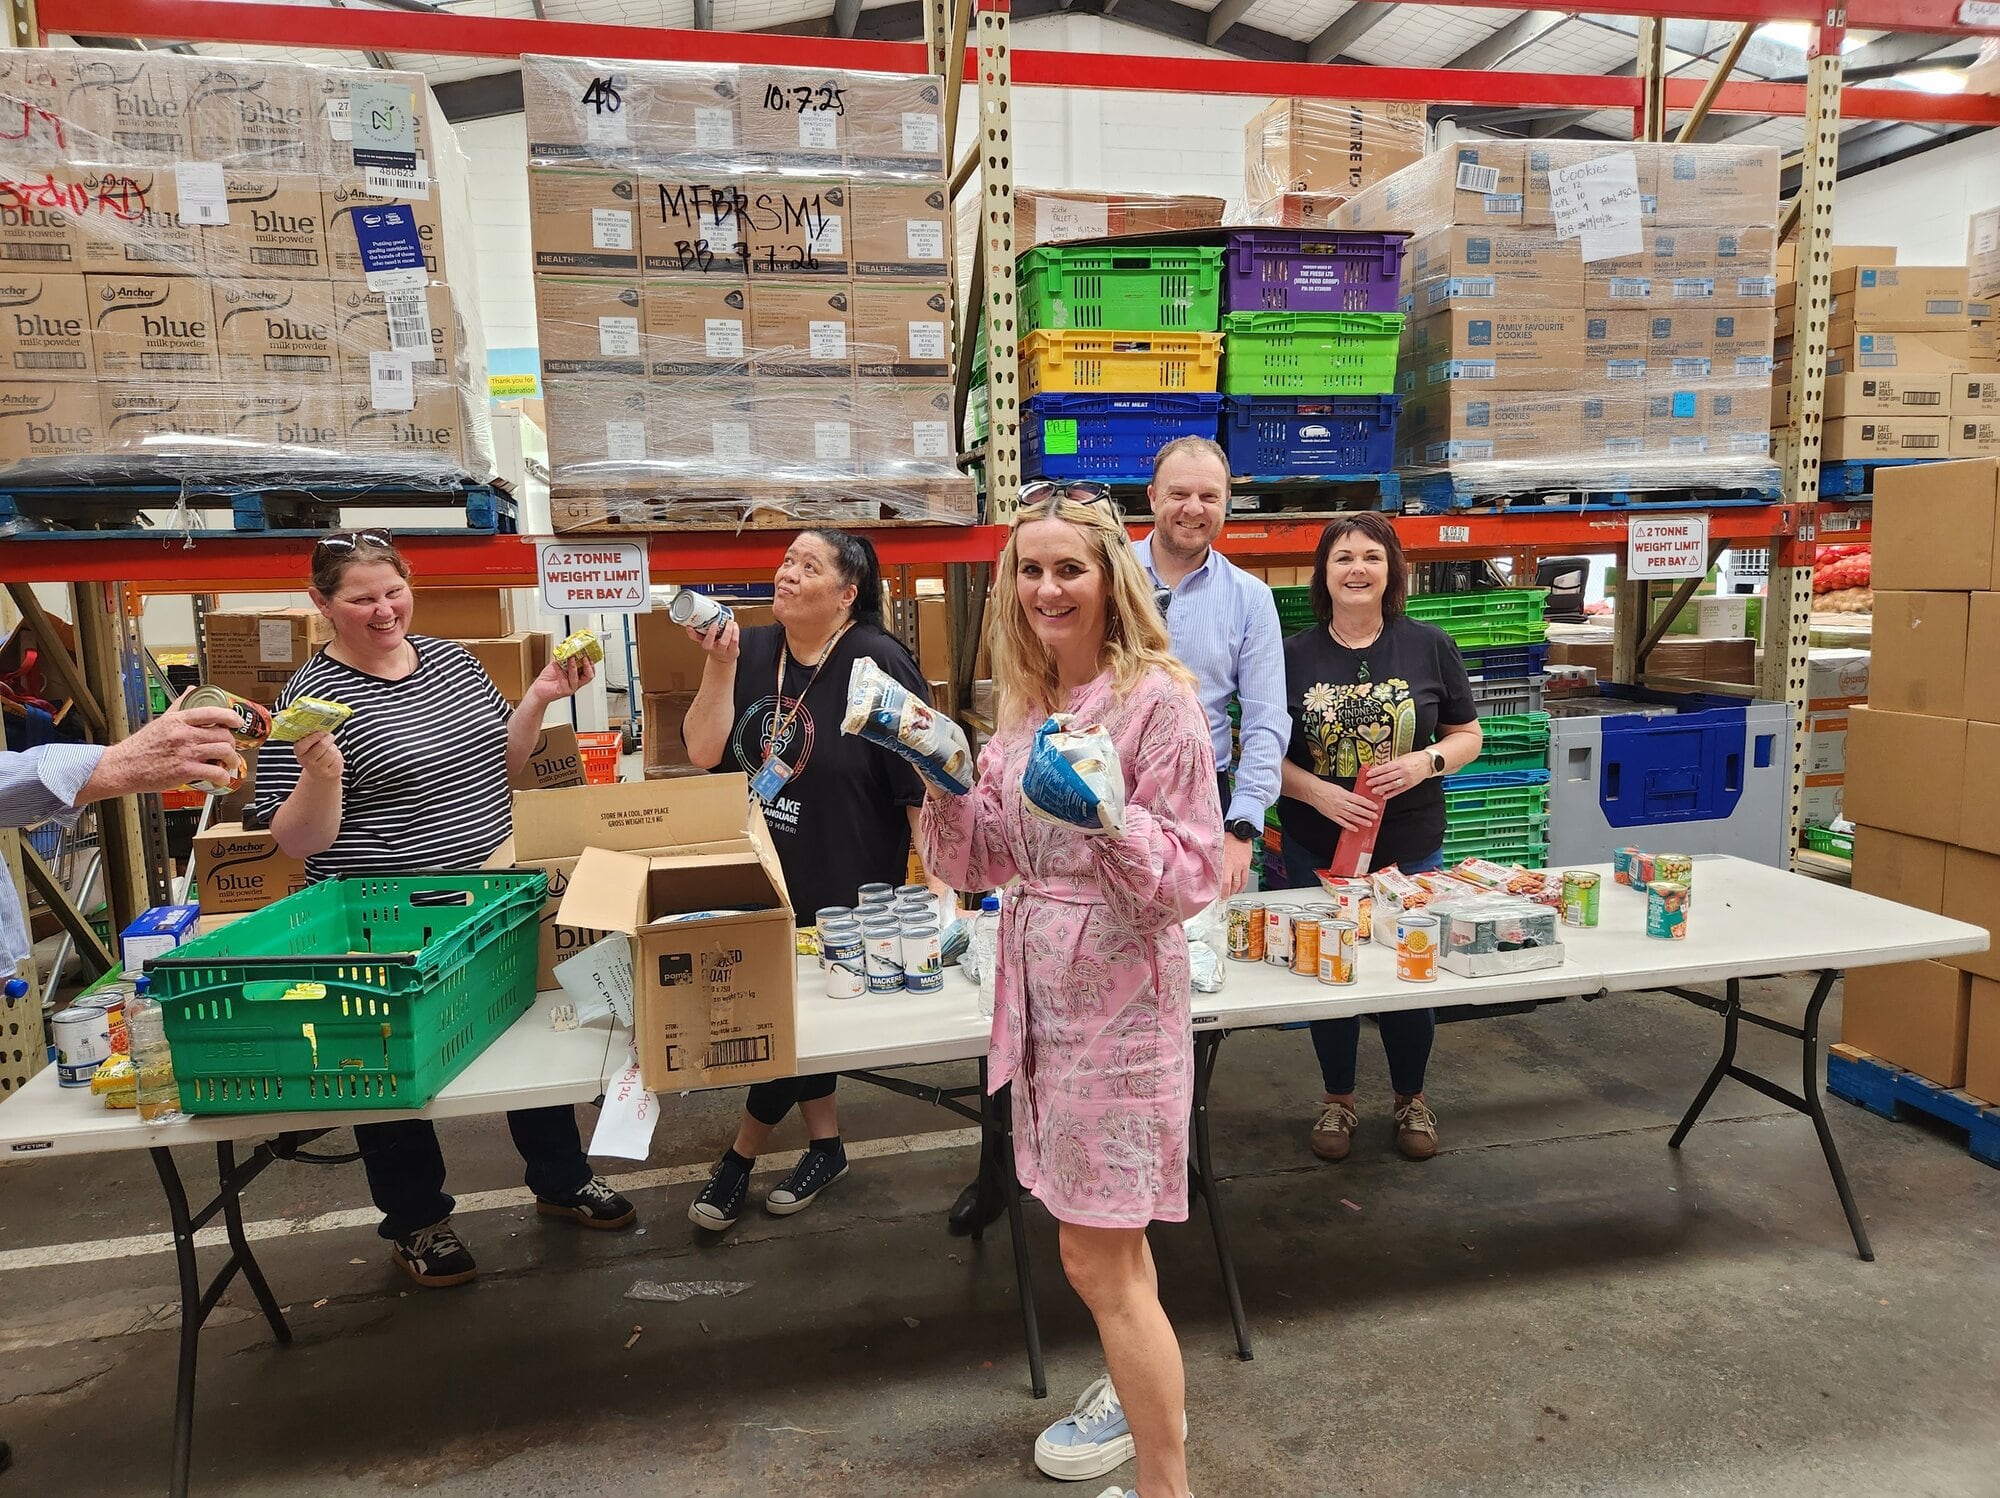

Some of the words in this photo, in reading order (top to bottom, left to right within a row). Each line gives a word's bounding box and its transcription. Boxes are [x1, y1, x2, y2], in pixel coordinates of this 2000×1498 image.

[582, 77, 621, 114] 48
[115, 92, 179, 118] blue
[1560, 163, 1608, 184] Cookies
[228, 180, 264, 191] Anchor
[1577, 192, 1586, 201] 10
[251, 209, 314, 234] blue
[4, 228, 27, 238] milk
[28, 229, 66, 240] powder
[256, 234, 277, 244] milk
[279, 235, 313, 245] powder
[117, 287, 155, 298] Anchor
[14, 314, 81, 337] blue
[141, 316, 207, 338] blue
[265, 318, 328, 341] blue
[19, 338, 43, 347] milk
[43, 338, 81, 348] powder
[169, 340, 206, 350] powder
[269, 341, 291, 350] milk
[291, 341, 327, 352] powder
[491, 376, 510, 385] Thank
[510, 378, 522, 387] you
[492, 387, 507, 397] your
[507, 386, 536, 395] donation
[4, 394, 40, 405] Anchor
[26, 422, 93, 444] blue
[276, 422, 337, 444] blue
[393, 423, 450, 445] blue
[1654, 526, 1688, 536] TONNE
[1634, 541, 1673, 553] WEIGHT
[1674, 540, 1701, 551] LIMIT
[563, 553, 572, 564] 2
[574, 552, 622, 564] TONNE
[1647, 557, 1667, 568] PER
[1667, 556, 1688, 567] BAY
[547, 571, 601, 583] WEIGHT
[603, 569, 641, 582] LIMIT
[567, 588, 594, 600] PER
[596, 588, 623, 600] BAY
[1344, 698, 1363, 709] LET
[1338, 702, 1382, 720] KINDNESS
[241, 712, 253, 734] DICED
[1345, 714, 1379, 728] BLOOM
[534, 756, 578, 778] blue
[538, 774, 553, 784] milk
[553, 769, 579, 782] powder
[776, 796, 802, 815] AKE
[601, 811, 617, 820] STORE
[628, 810, 642, 819] COOL,
[654, 807, 669, 816] PLACE
[761, 807, 799, 825] LANGUAGE
[228, 842, 265, 853] Anchor
[215, 874, 263, 891] blue
[218, 889, 235, 898] milk
[235, 889, 263, 898] powder
[592, 972, 606, 990] DC
[602, 991, 619, 1017] PICK
